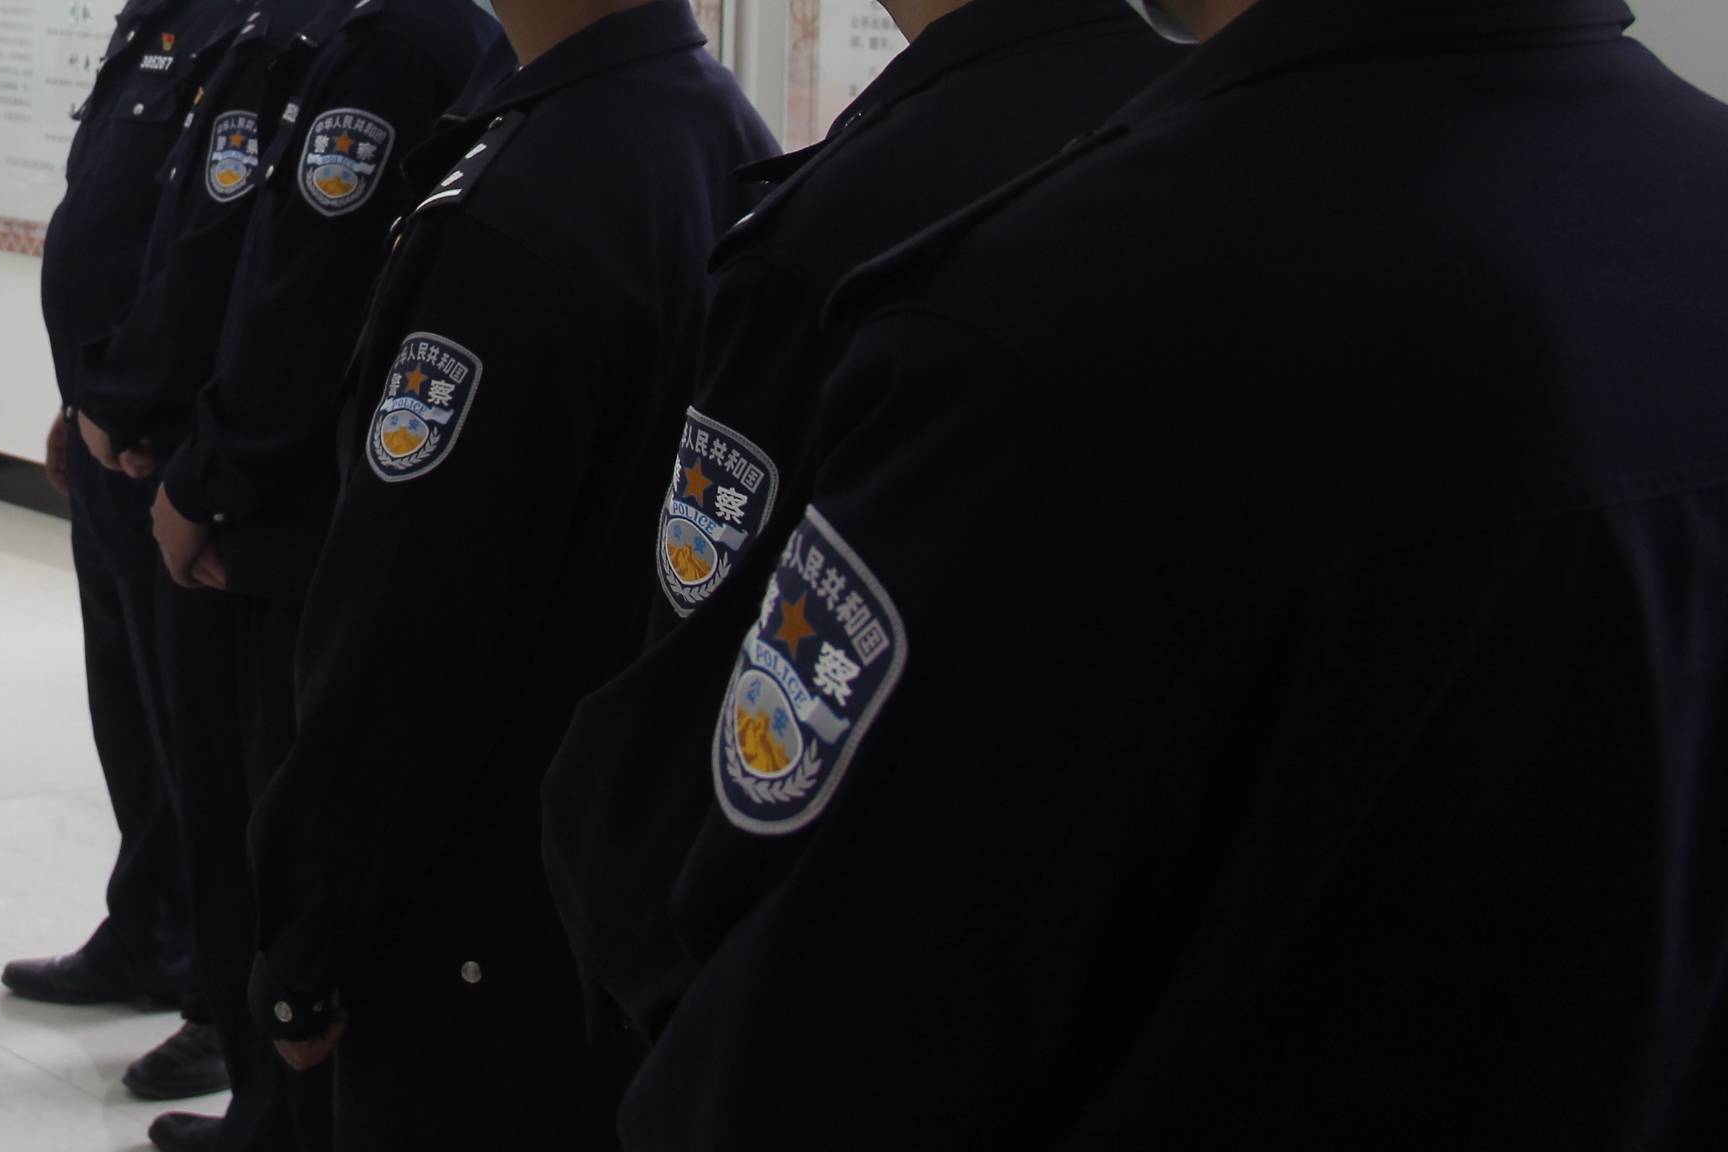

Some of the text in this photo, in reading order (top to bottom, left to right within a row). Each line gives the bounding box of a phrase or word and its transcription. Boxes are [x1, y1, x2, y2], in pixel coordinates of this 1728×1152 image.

[427, 380, 456, 407] 察
[681, 421, 765, 494] 人民共和国
[672, 501, 718, 536] POLICE
[714, 485, 748, 525] 察
[756, 645, 807, 710] POLICE
[813, 641, 861, 707] 察
